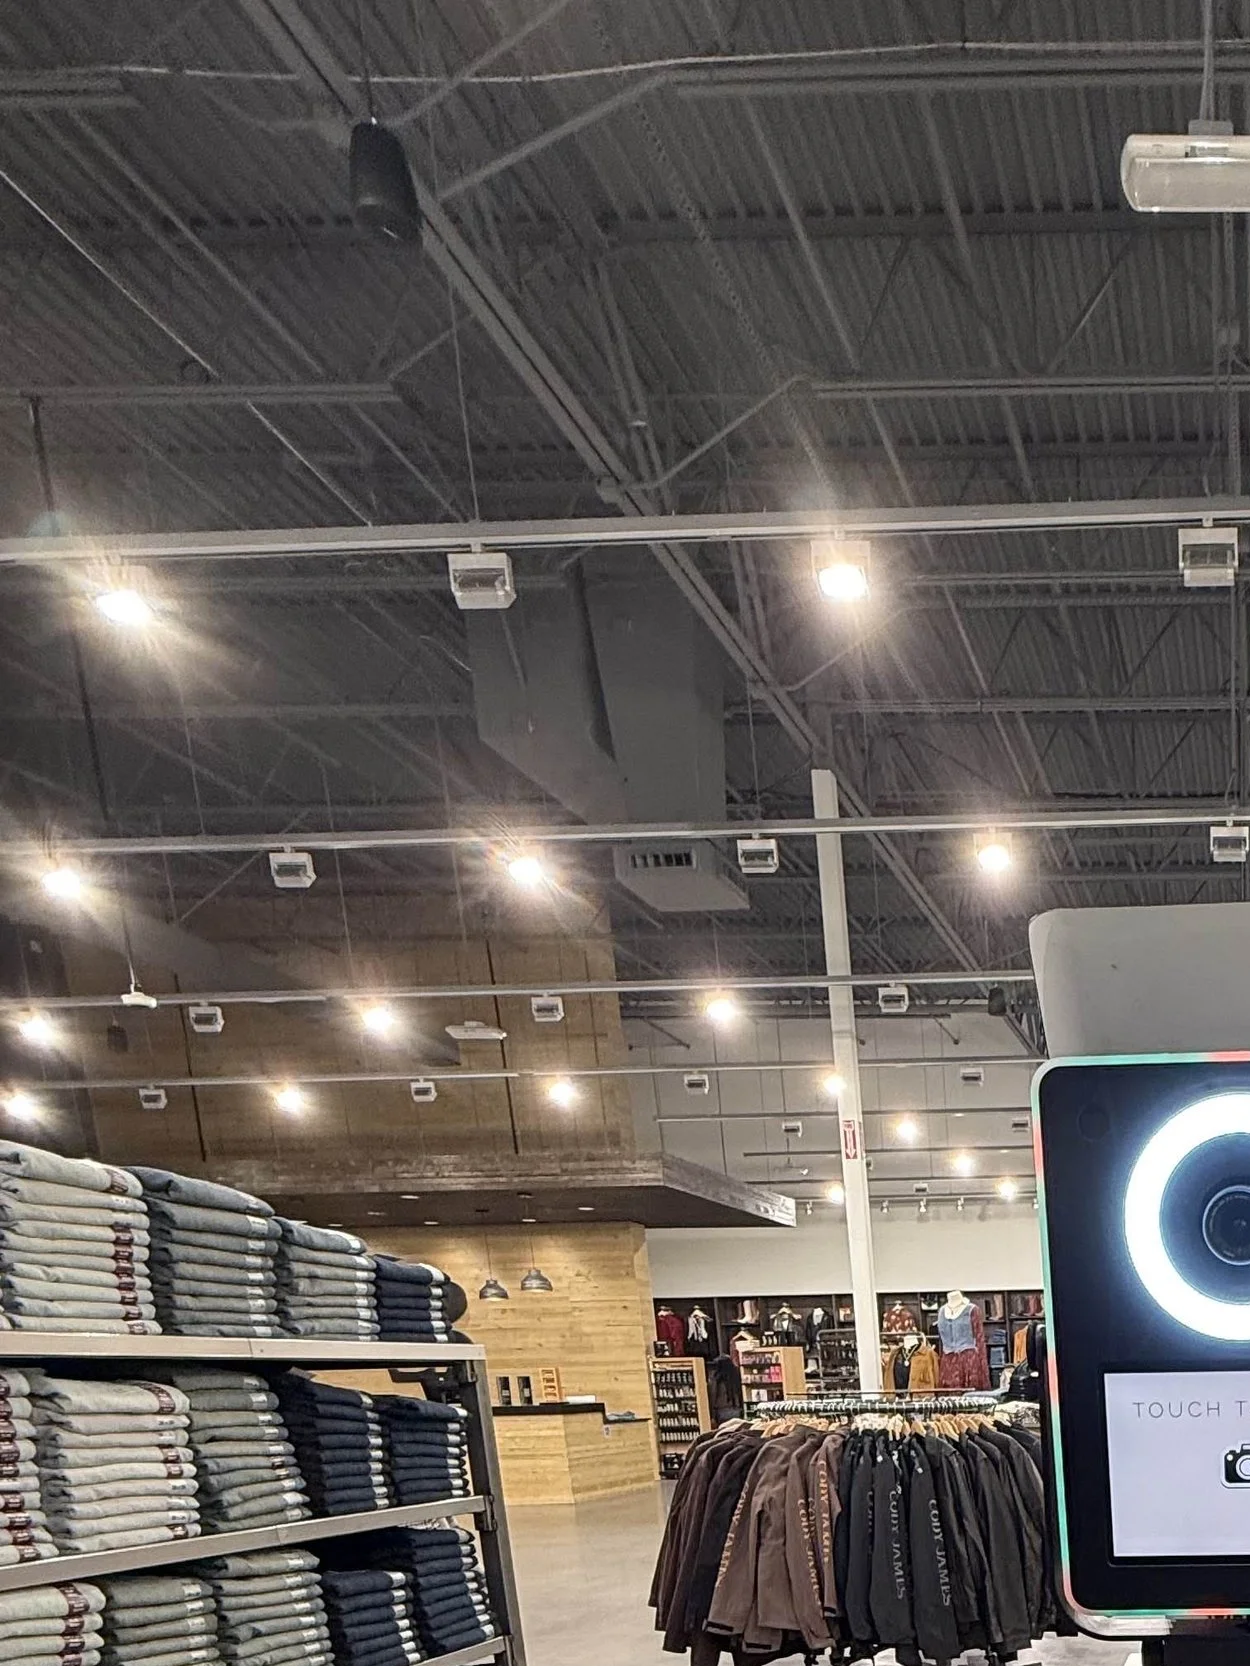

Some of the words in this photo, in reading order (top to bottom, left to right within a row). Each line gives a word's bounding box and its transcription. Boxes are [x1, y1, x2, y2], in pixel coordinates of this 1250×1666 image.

[1132, 1401, 1221, 1418] TOUCH
[889, 1490, 900, 1534] CODY
[928, 1499, 944, 1543] CODY
[892, 1540, 907, 1600] JAMES
[935, 1545, 953, 1607] JAMES
